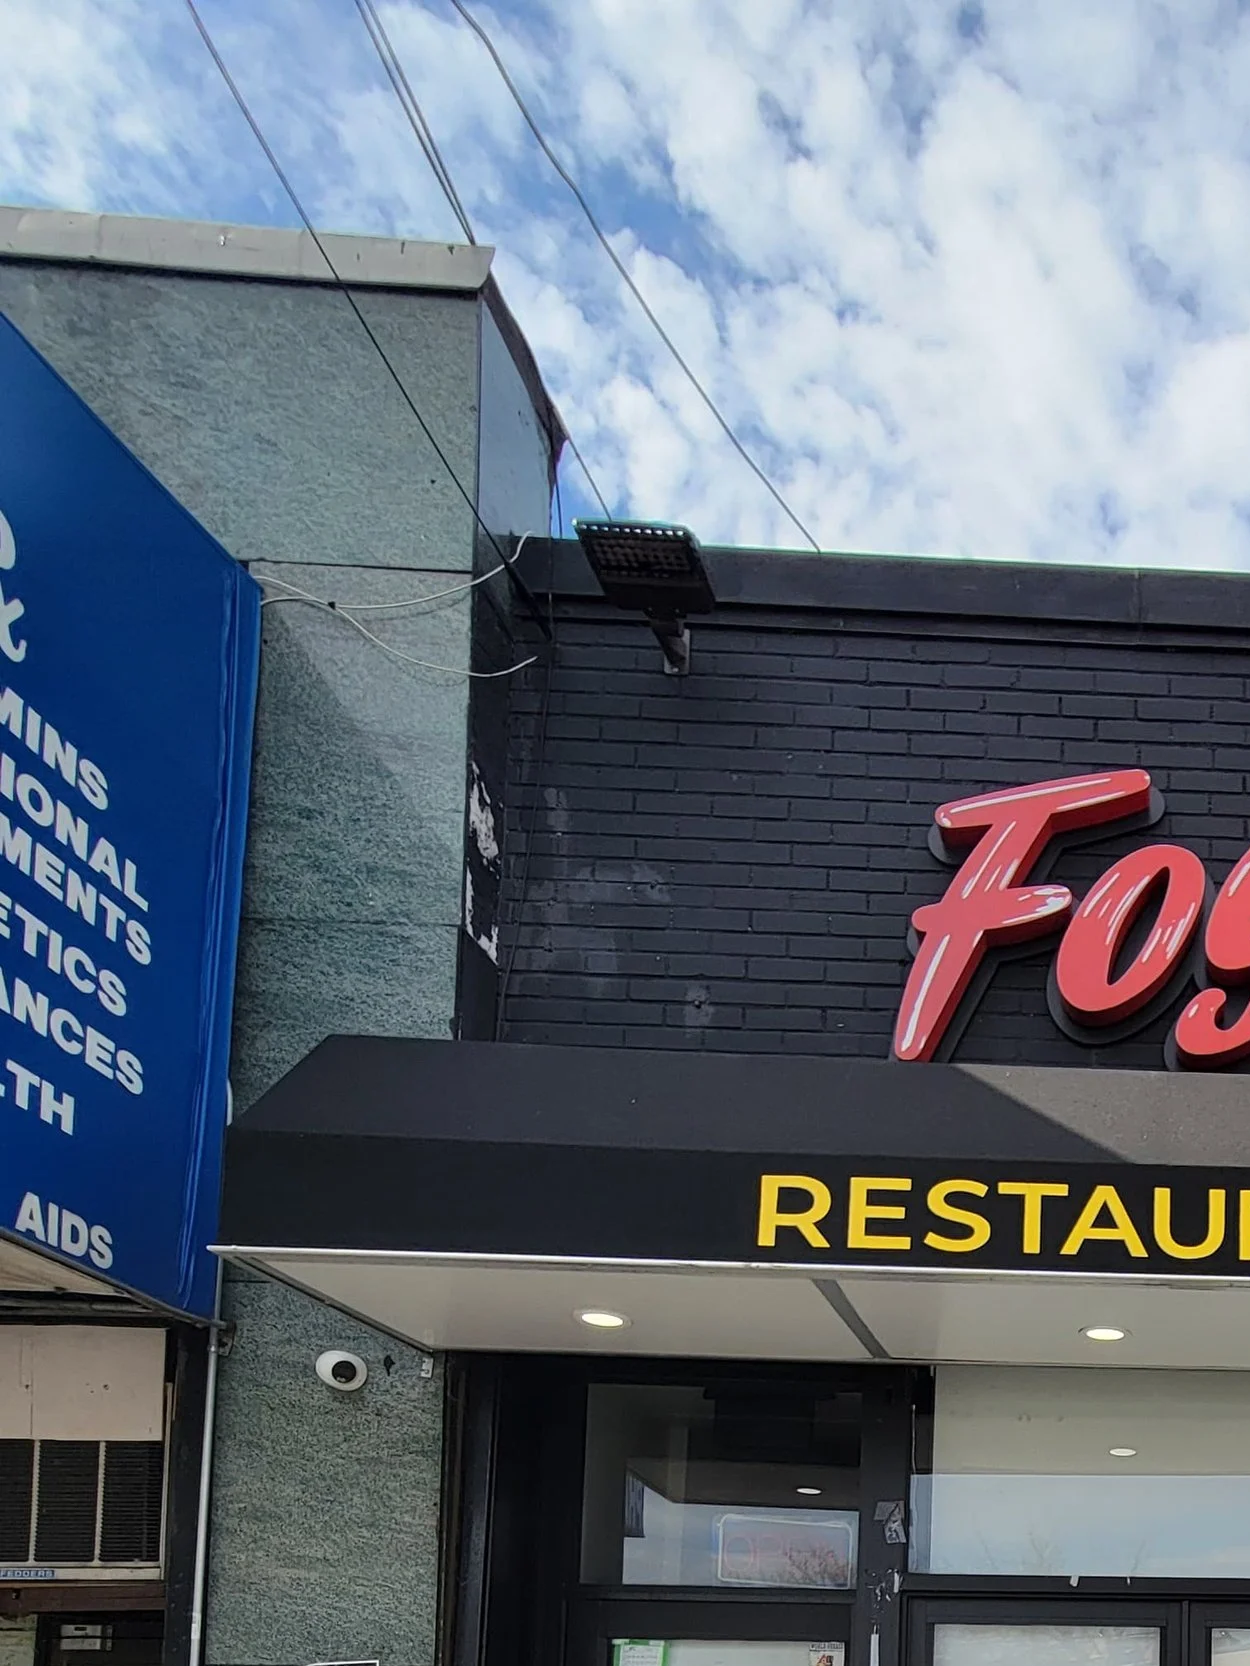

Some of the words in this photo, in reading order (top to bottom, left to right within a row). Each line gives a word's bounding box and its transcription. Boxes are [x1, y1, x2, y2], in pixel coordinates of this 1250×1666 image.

[0, 966, 143, 1095] NCES
[0, 1058, 75, 1136] TH
[15, 1191, 113, 1270] AIDS
